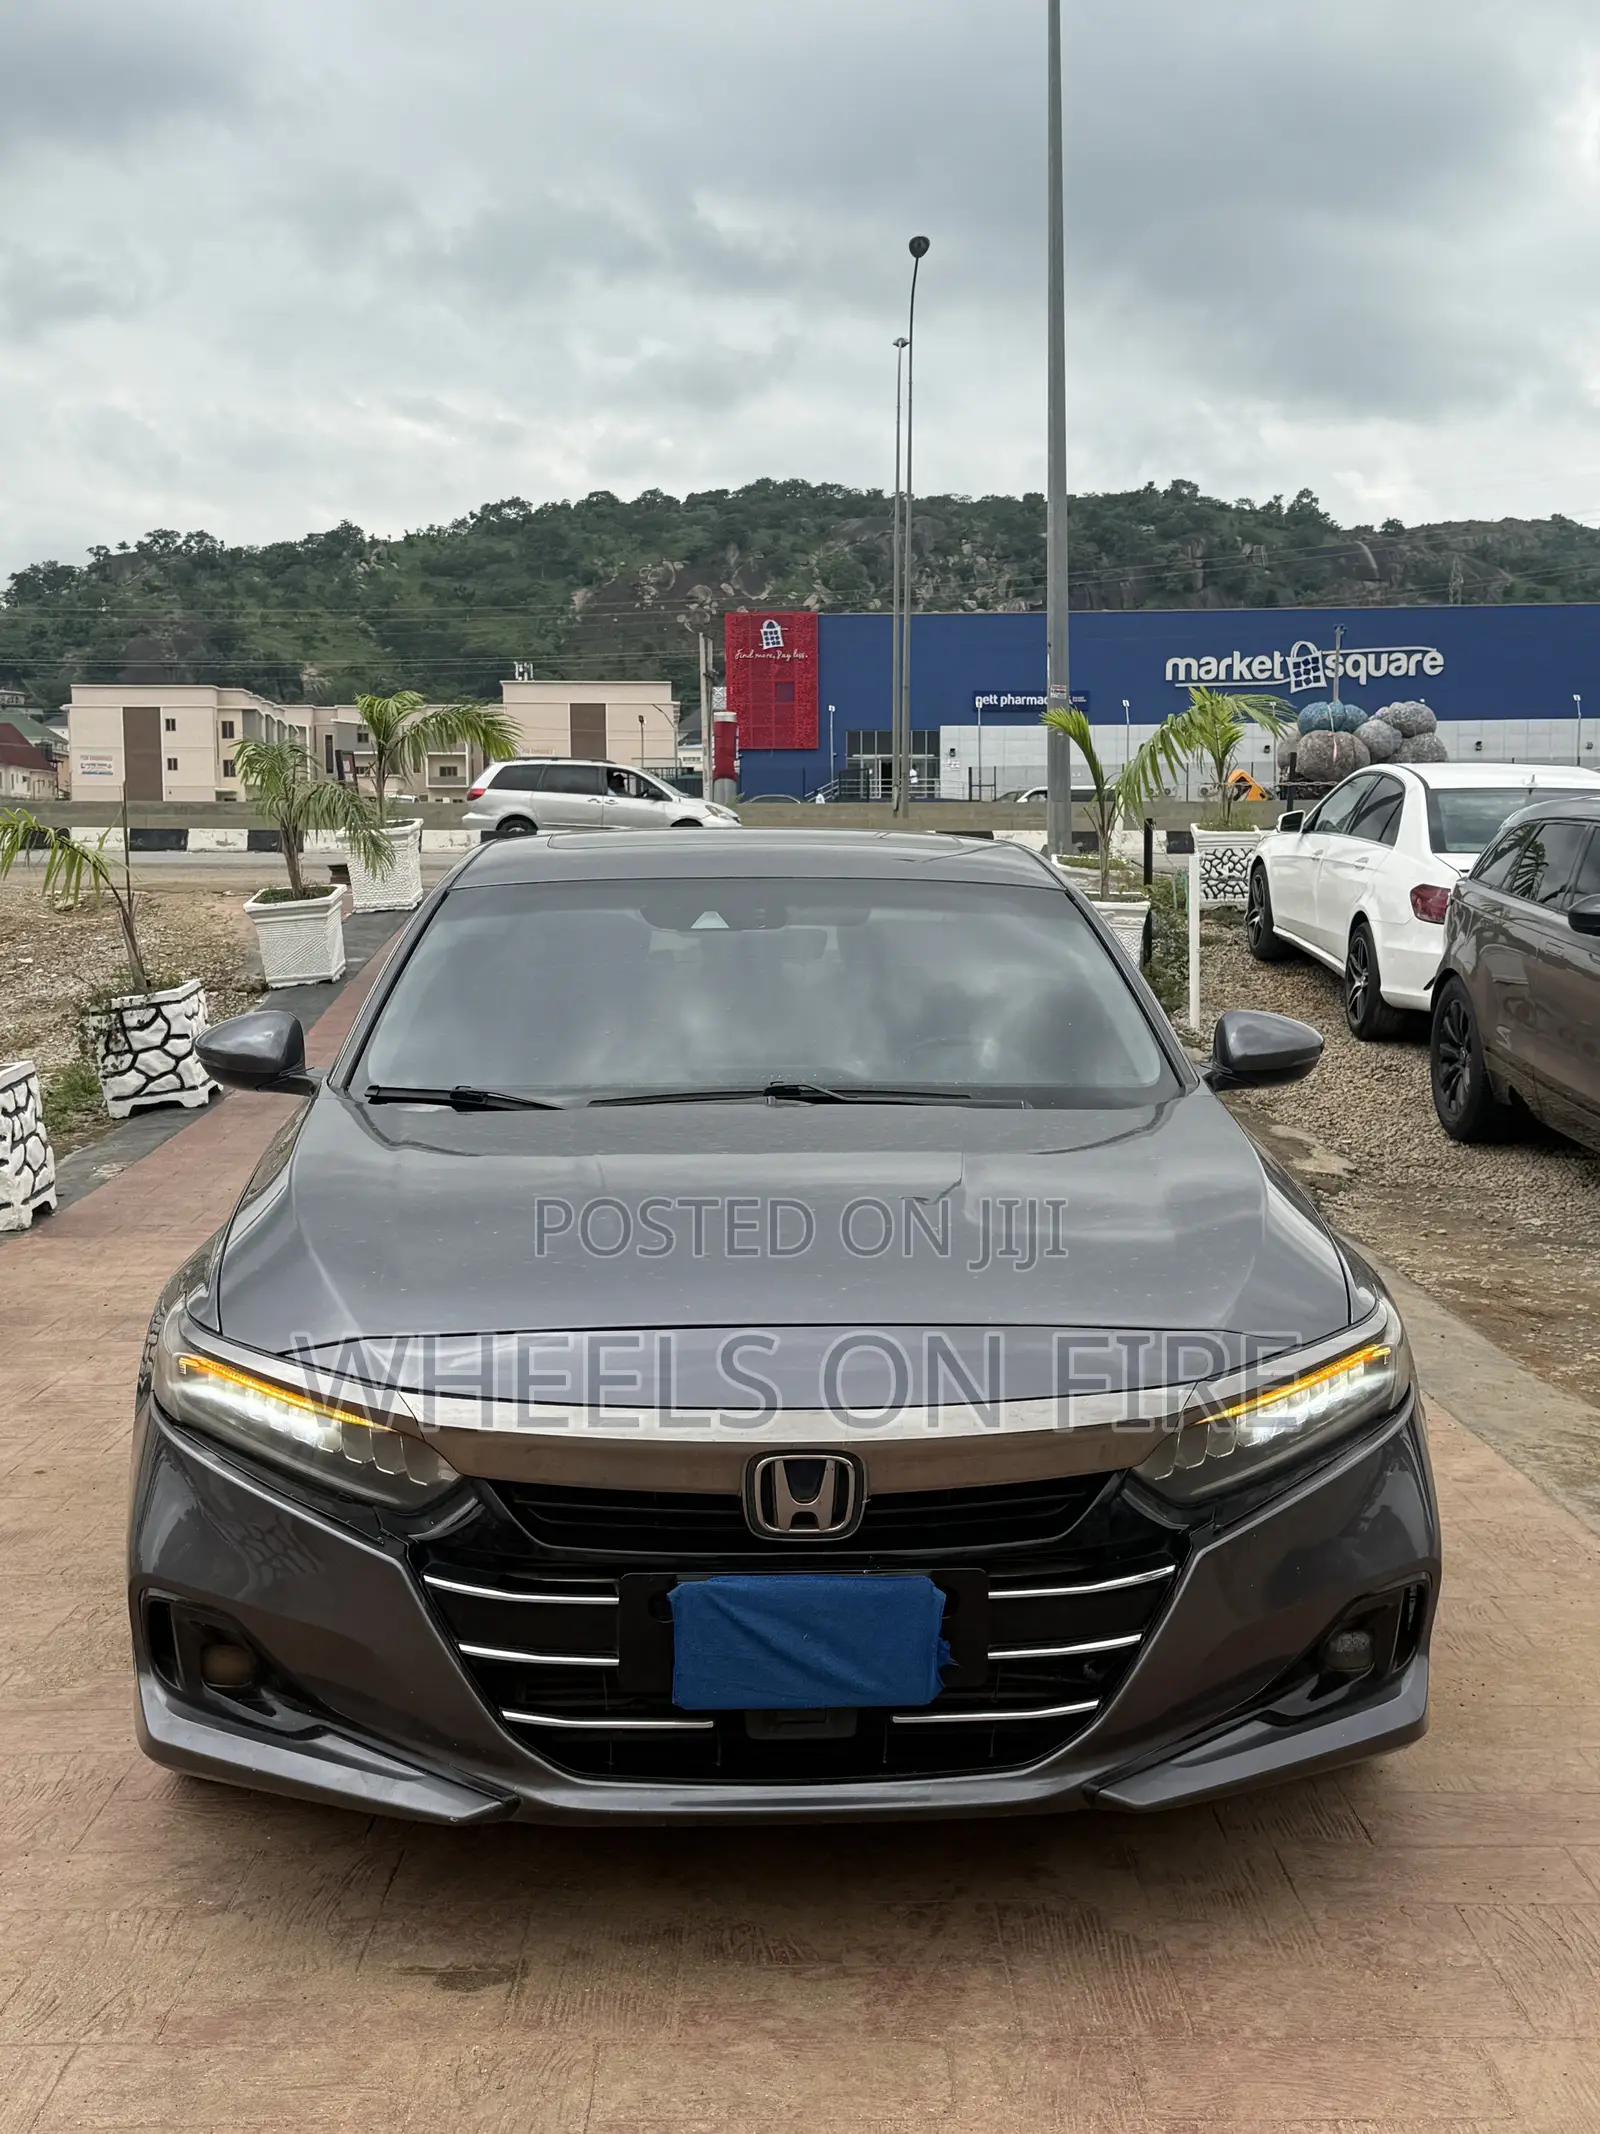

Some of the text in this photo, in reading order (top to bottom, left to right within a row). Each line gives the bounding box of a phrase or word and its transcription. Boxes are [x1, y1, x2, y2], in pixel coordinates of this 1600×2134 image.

[735, 649, 755, 659] Find
[755, 652, 775, 660] more,
[1165, 651, 1445, 685] market square
[1000, 693, 1048, 707] pharmac
